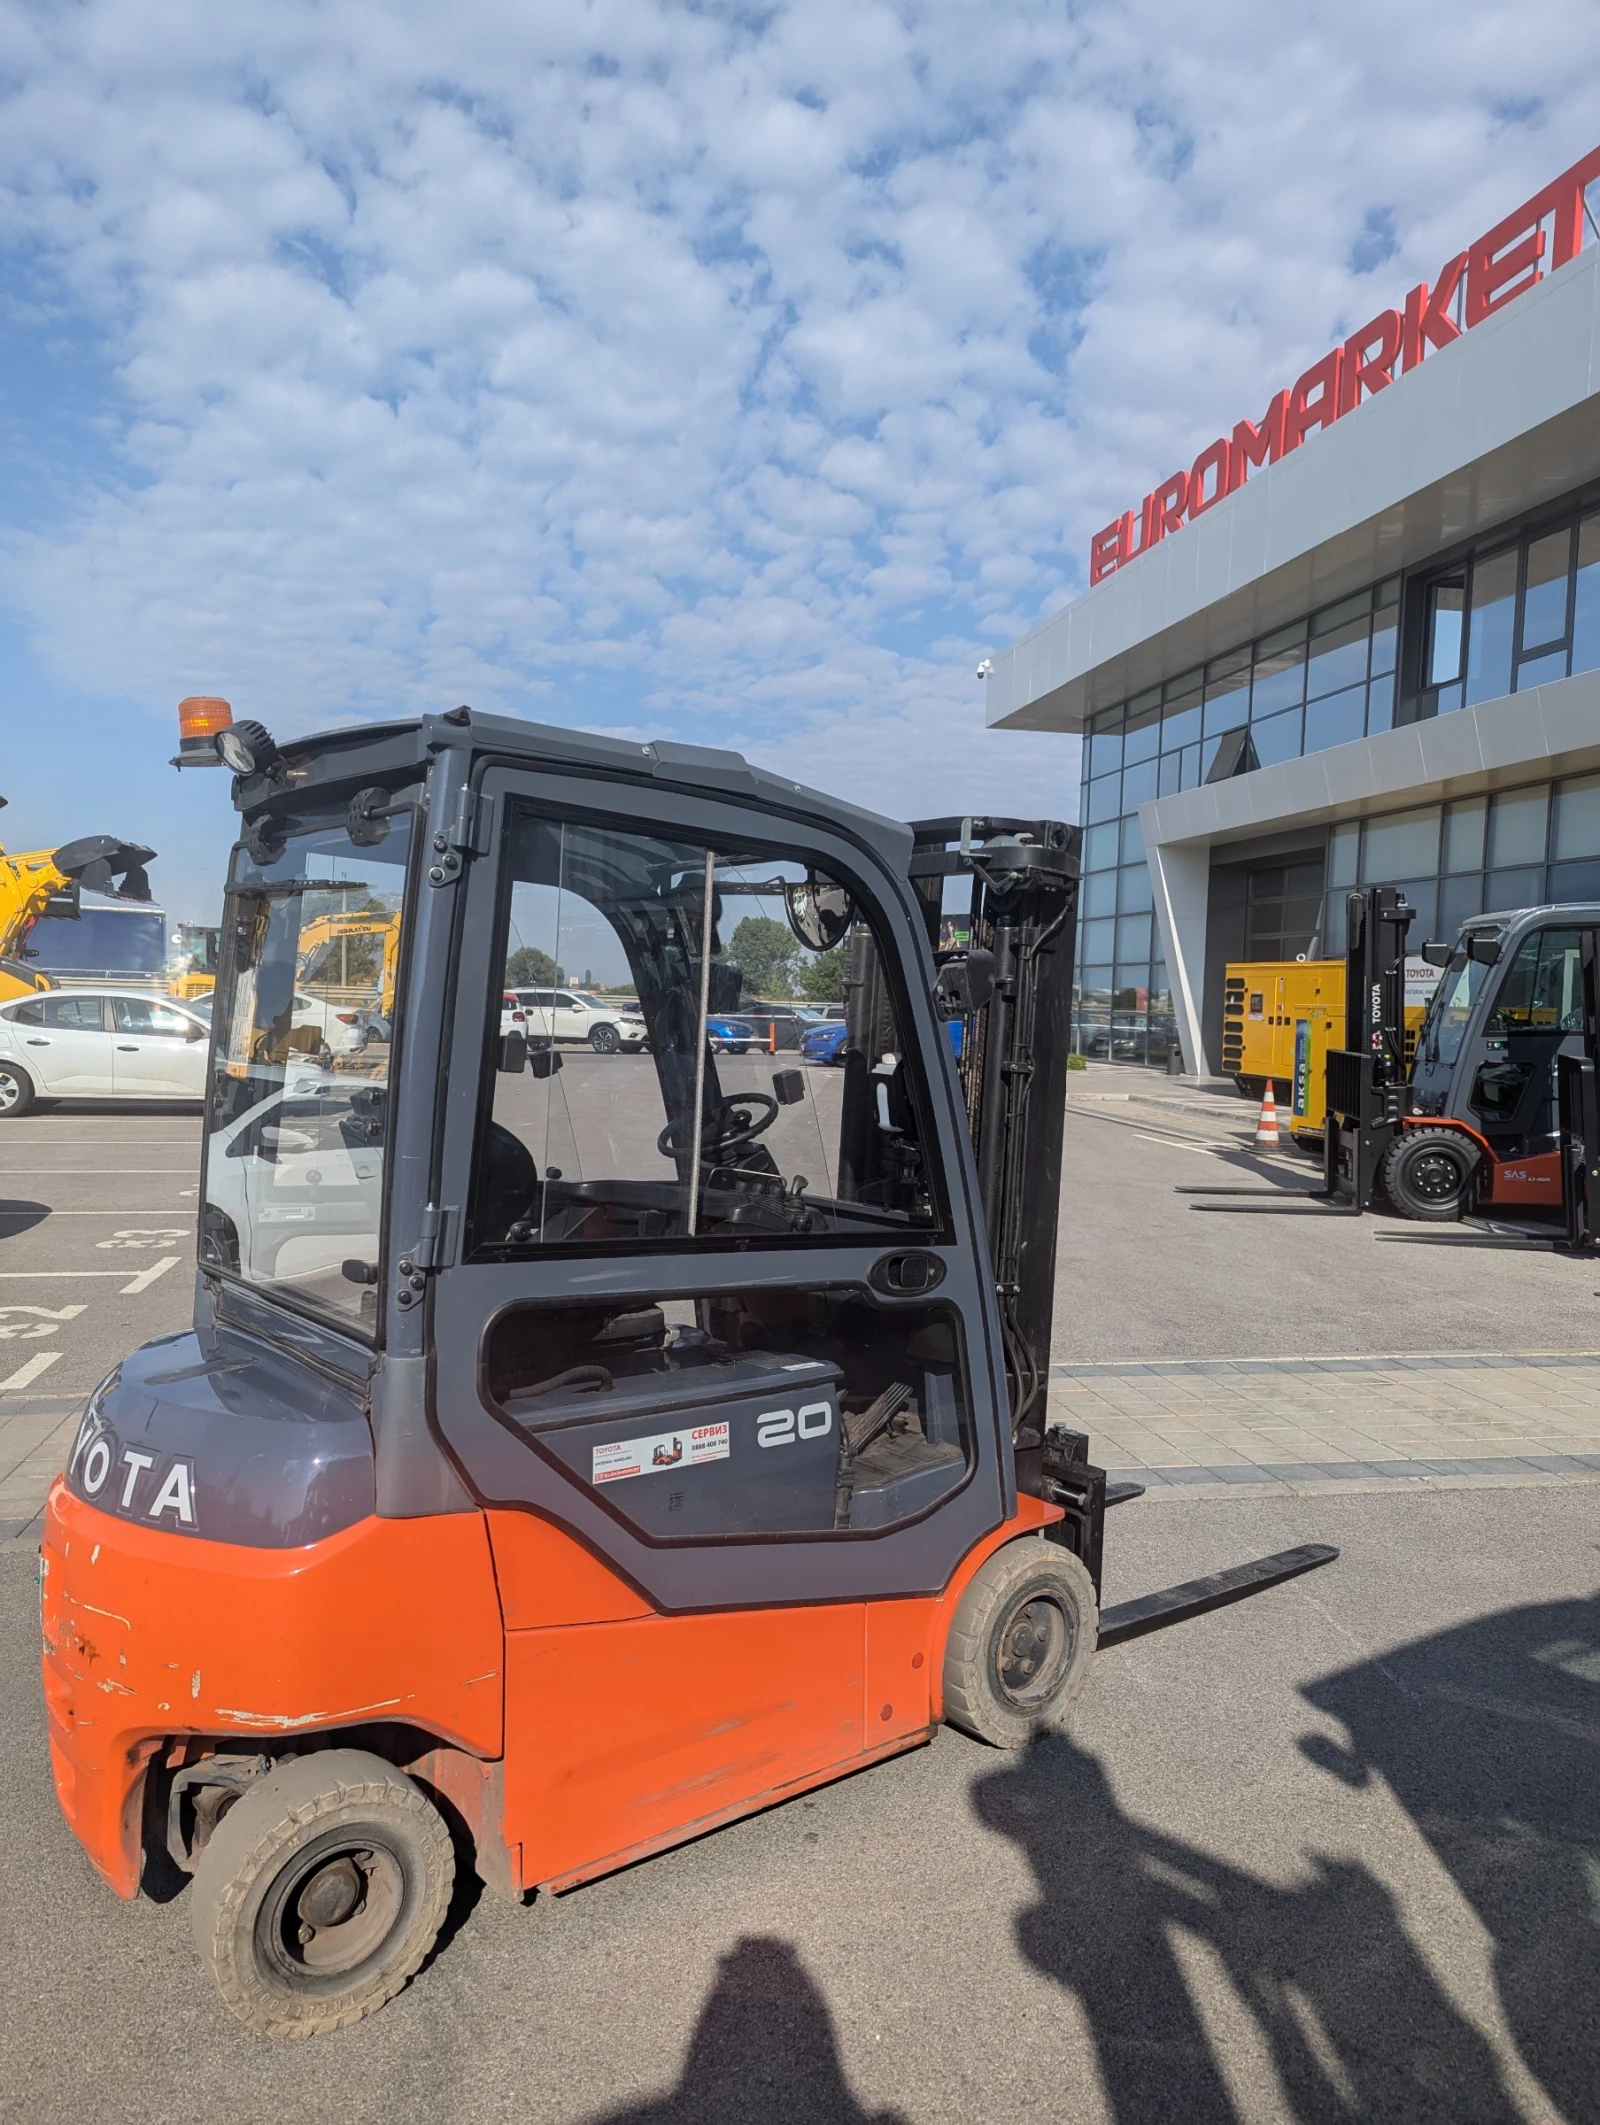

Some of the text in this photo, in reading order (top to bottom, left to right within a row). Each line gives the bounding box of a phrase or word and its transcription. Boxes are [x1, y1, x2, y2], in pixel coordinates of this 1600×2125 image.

[1090, 145, 1600, 588] EUROMARKET
[1406, 968, 1435, 978] TOYOTA
[1371, 984, 1381, 1024] TOYOTA
[1297, 1063, 1306, 1109] aksa
[1504, 1170, 1526, 1179] SAS
[692, 1424, 727, 1439] СЕРВИЗ
[757, 1401, 832, 1448] 20
[595, 1444, 621, 1455] TOYOTA
